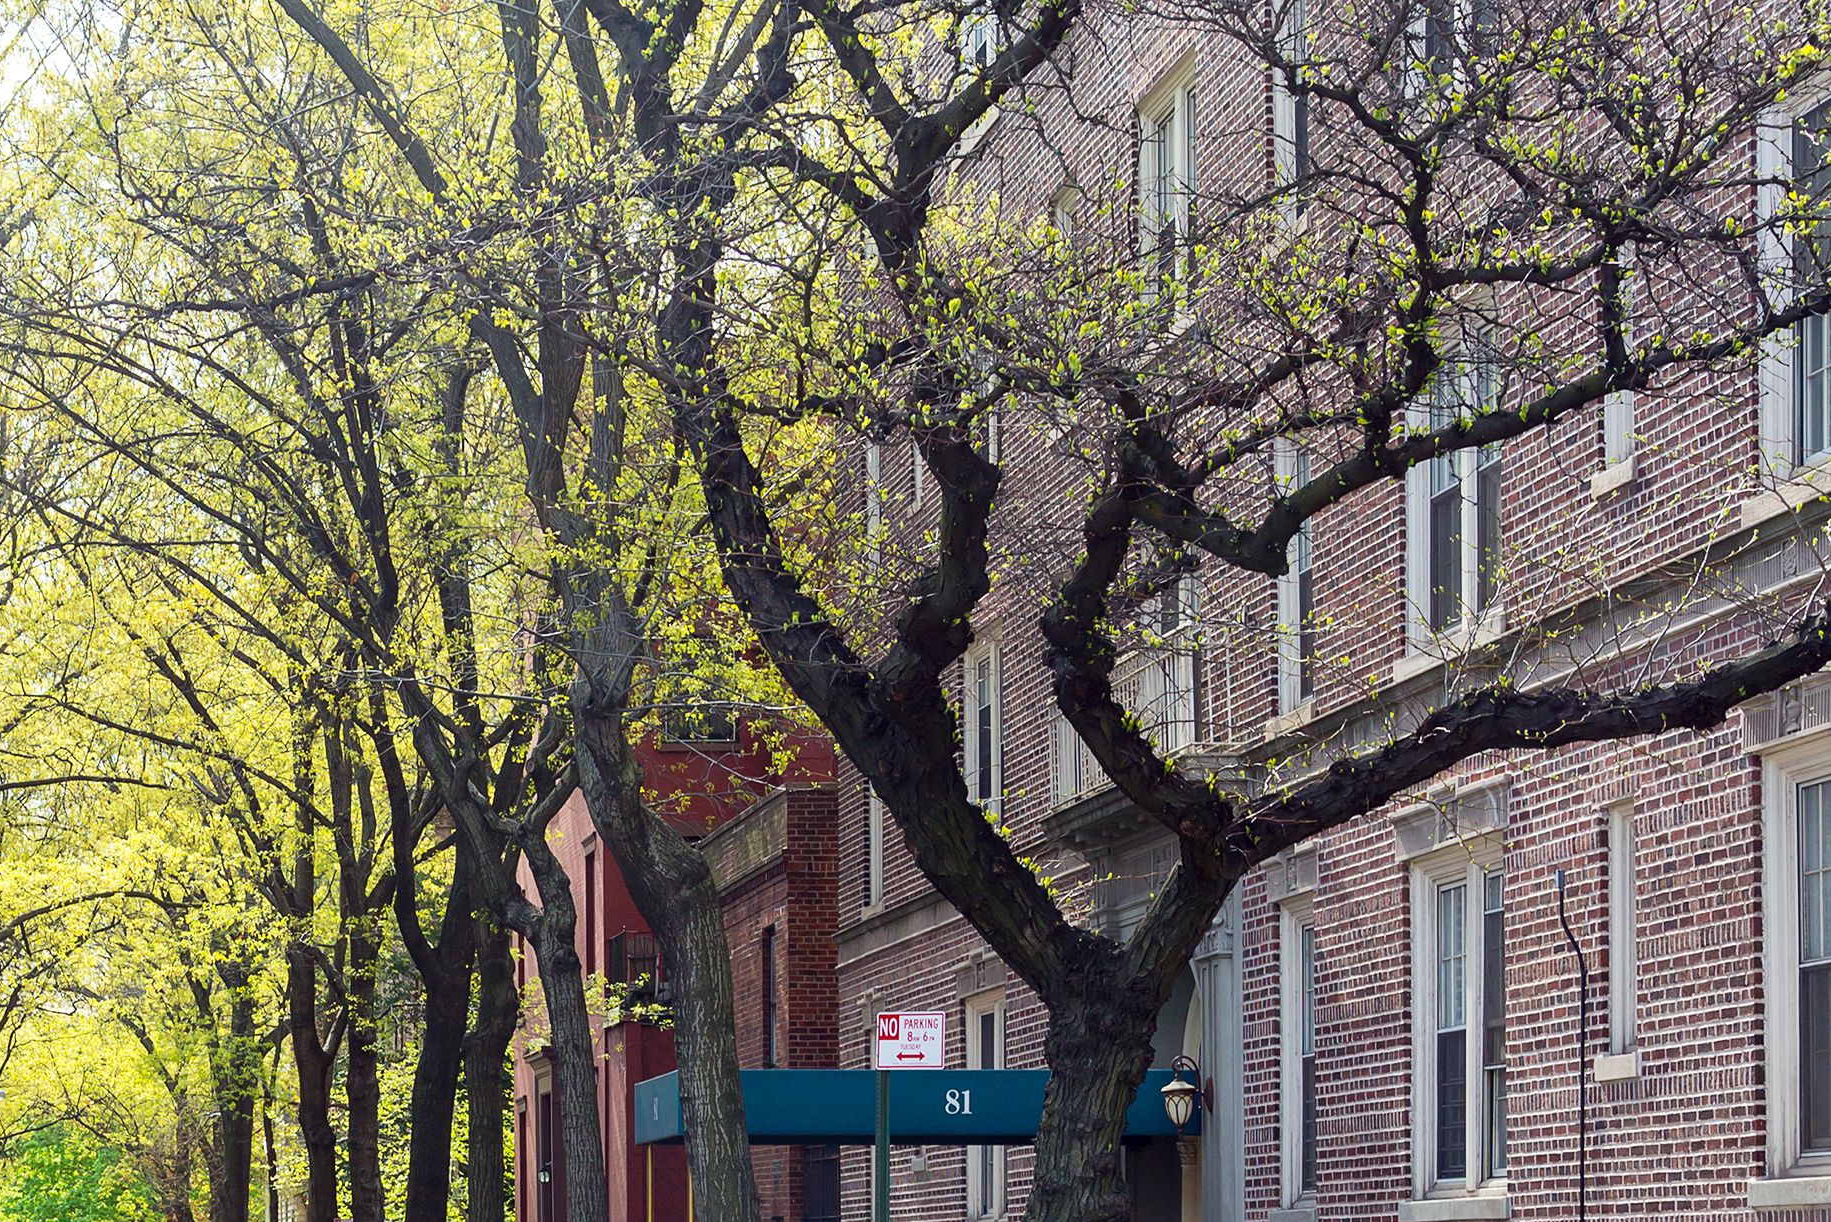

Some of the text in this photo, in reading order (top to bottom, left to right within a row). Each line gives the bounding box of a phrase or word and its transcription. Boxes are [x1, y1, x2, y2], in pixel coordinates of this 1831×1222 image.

[879, 1017, 898, 1037] NO
[904, 1018, 939, 1030] PARKING
[944, 1089, 972, 1115] 81
